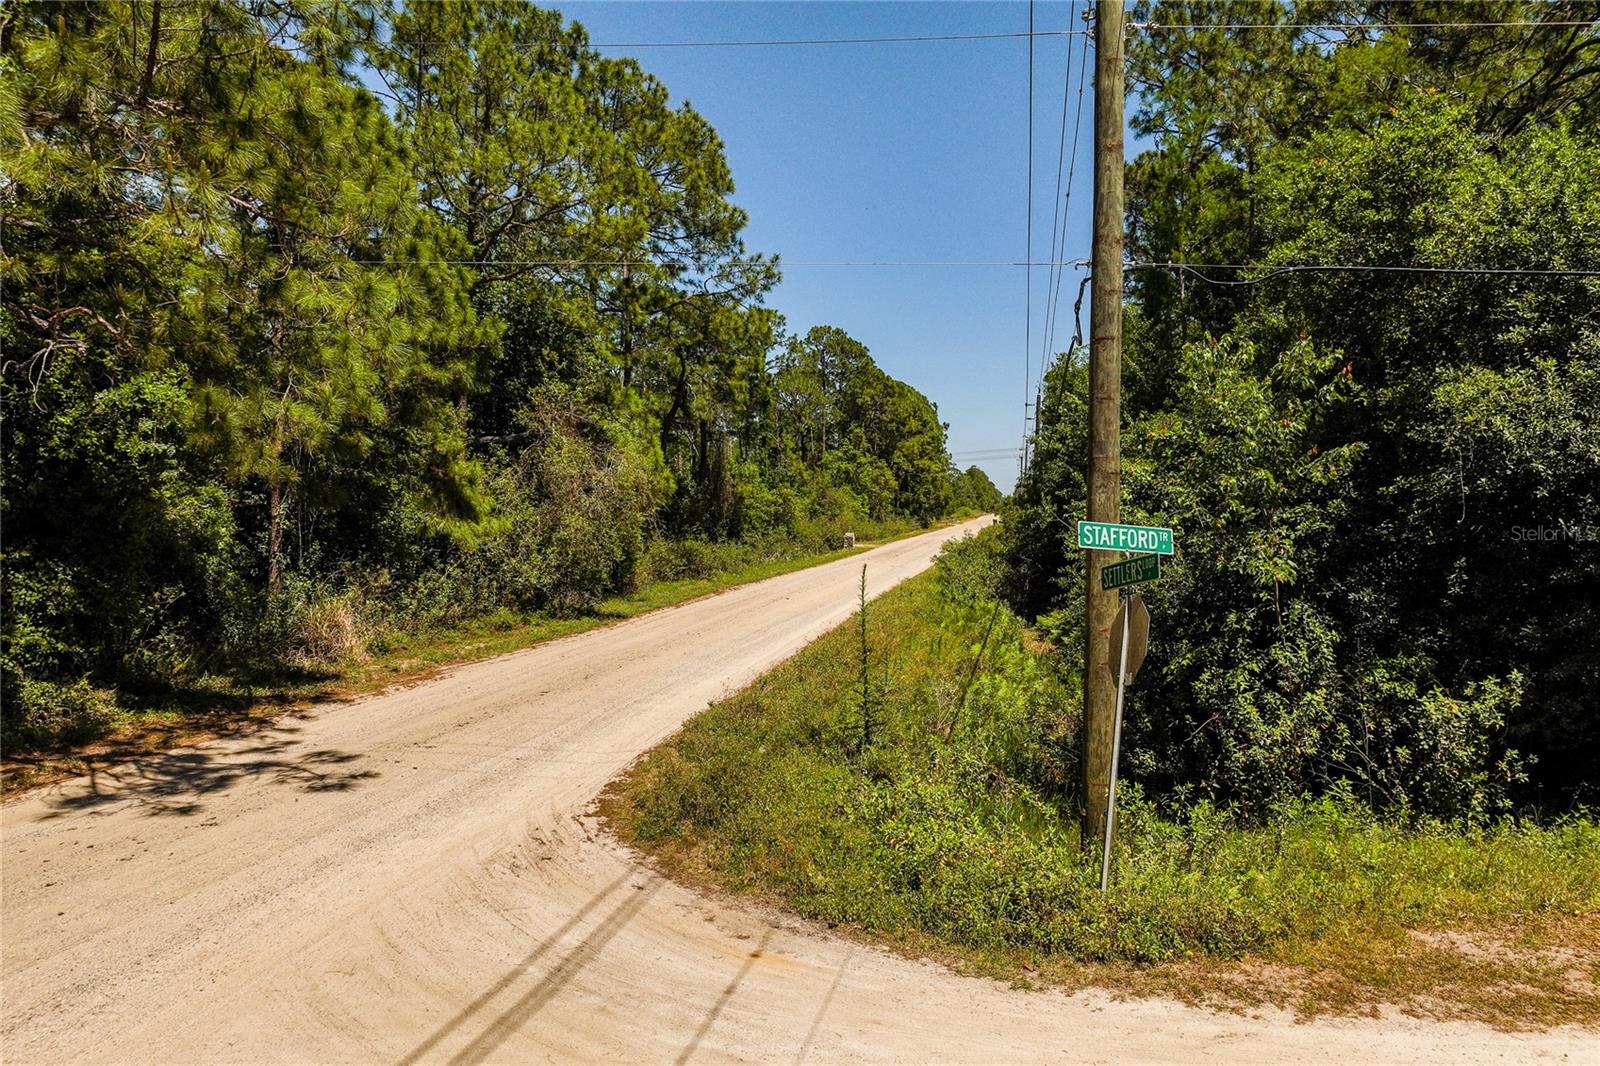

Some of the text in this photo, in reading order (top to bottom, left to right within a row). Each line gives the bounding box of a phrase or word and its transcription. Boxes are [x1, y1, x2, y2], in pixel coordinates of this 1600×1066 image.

[1083, 525, 1169, 549] STAFFORD TR
[1103, 560, 1143, 588] SETTLERS
